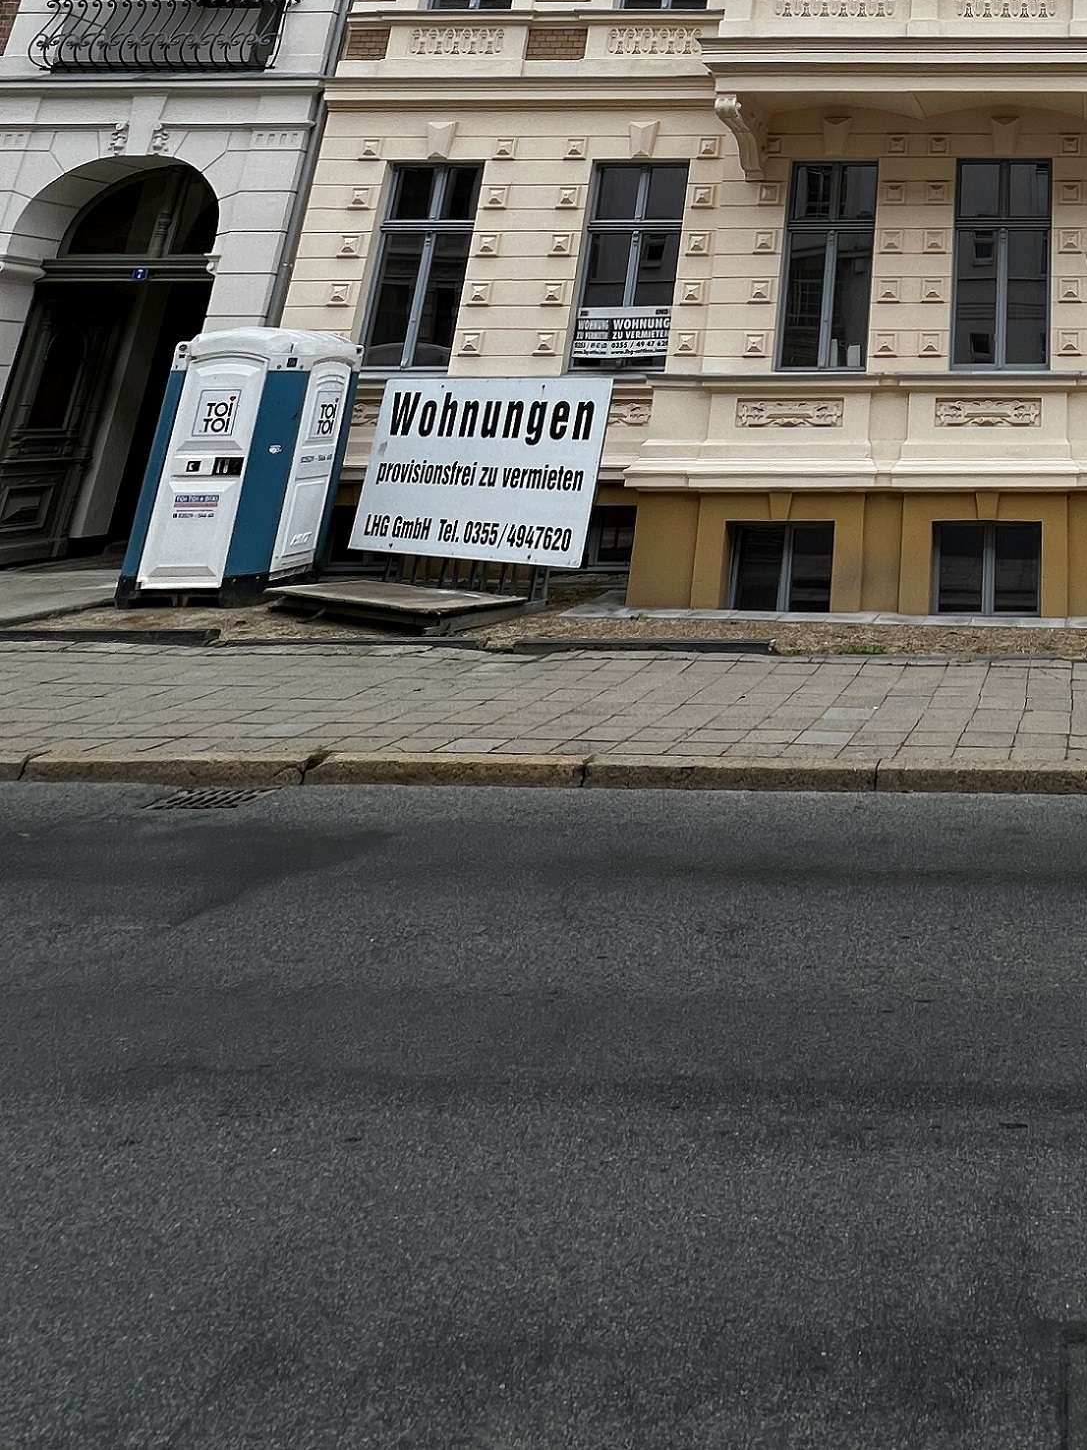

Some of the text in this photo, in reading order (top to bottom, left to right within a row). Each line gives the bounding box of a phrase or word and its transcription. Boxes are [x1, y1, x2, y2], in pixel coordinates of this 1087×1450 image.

[137, 269, 144, 279] 7
[613, 318, 670, 330] WOHNUNG
[612, 331, 623, 339] ZU
[611, 341, 628, 349] 0355
[207, 396, 236, 417] TOI
[320, 398, 339, 419] TOI
[203, 418, 230, 432] TOI
[389, 391, 595, 445] Wohnungen
[317, 420, 334, 434] TOI
[376, 459, 585, 491] provisionsfrei zu vermieten
[364, 513, 572, 551] LHG GmbH Tel. 0355/4947620
